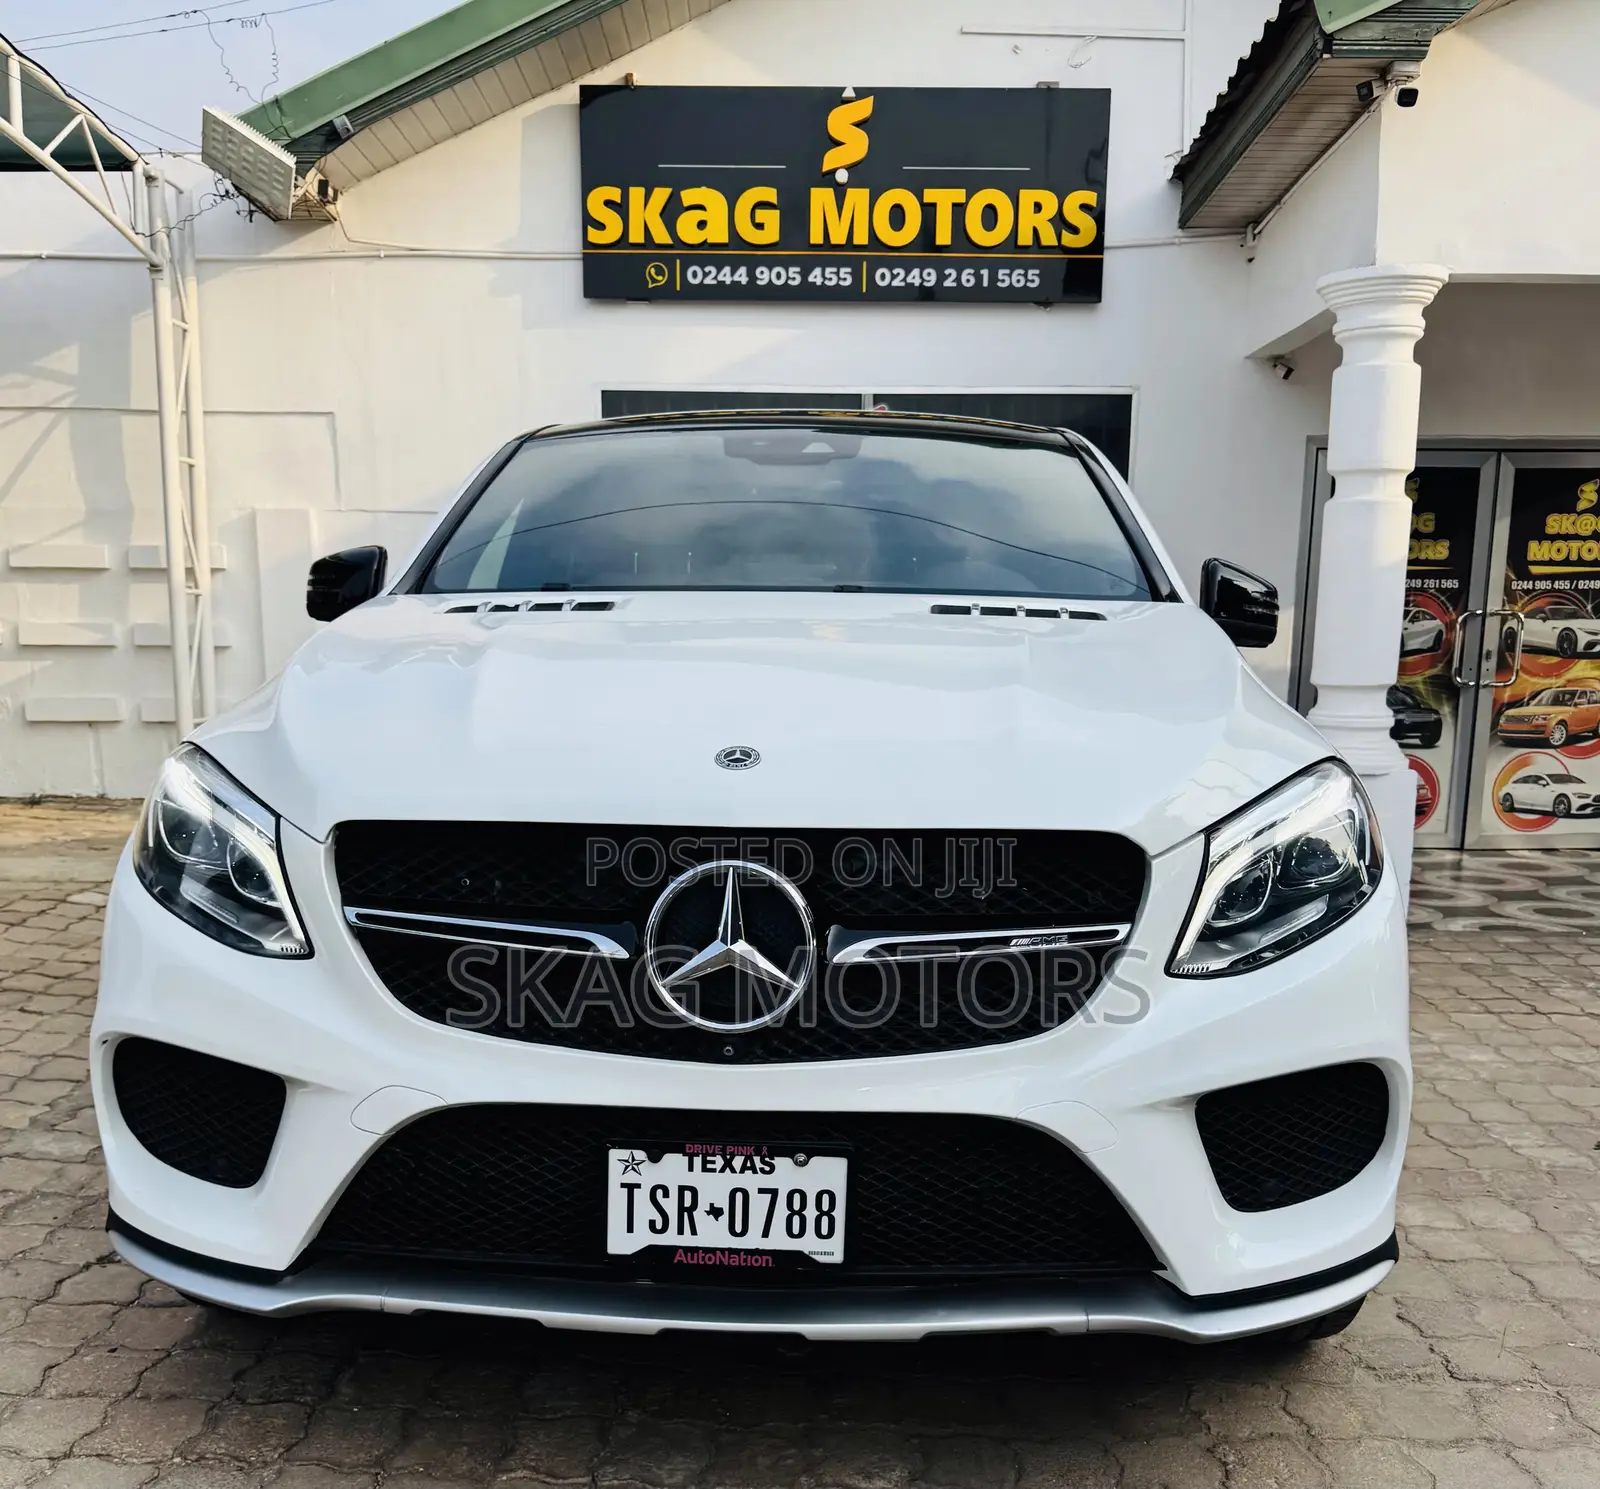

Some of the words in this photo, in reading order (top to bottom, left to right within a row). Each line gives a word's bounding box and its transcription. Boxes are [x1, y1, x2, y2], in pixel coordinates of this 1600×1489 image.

[808, 187, 1099, 249] MOTORS
[686, 265, 749, 285] 0244
[755, 266, 802, 286] 905
[807, 267, 853, 287] 455
[874, 267, 937, 287] 0249
[942, 268, 989, 288] 261
[996, 269, 1041, 288] 565
[1423, 579, 1440, 589] 261
[1440, 579, 1459, 589] 565
[1511, 580, 1533, 590] 0244
[1534, 580, 1552, 590] 905
[1553, 580, 1571, 590] 455
[685, 1143, 723, 1154] DRIVE
[726, 1145, 756, 1156] PINK
[685, 1153, 776, 1176] TEXAS
